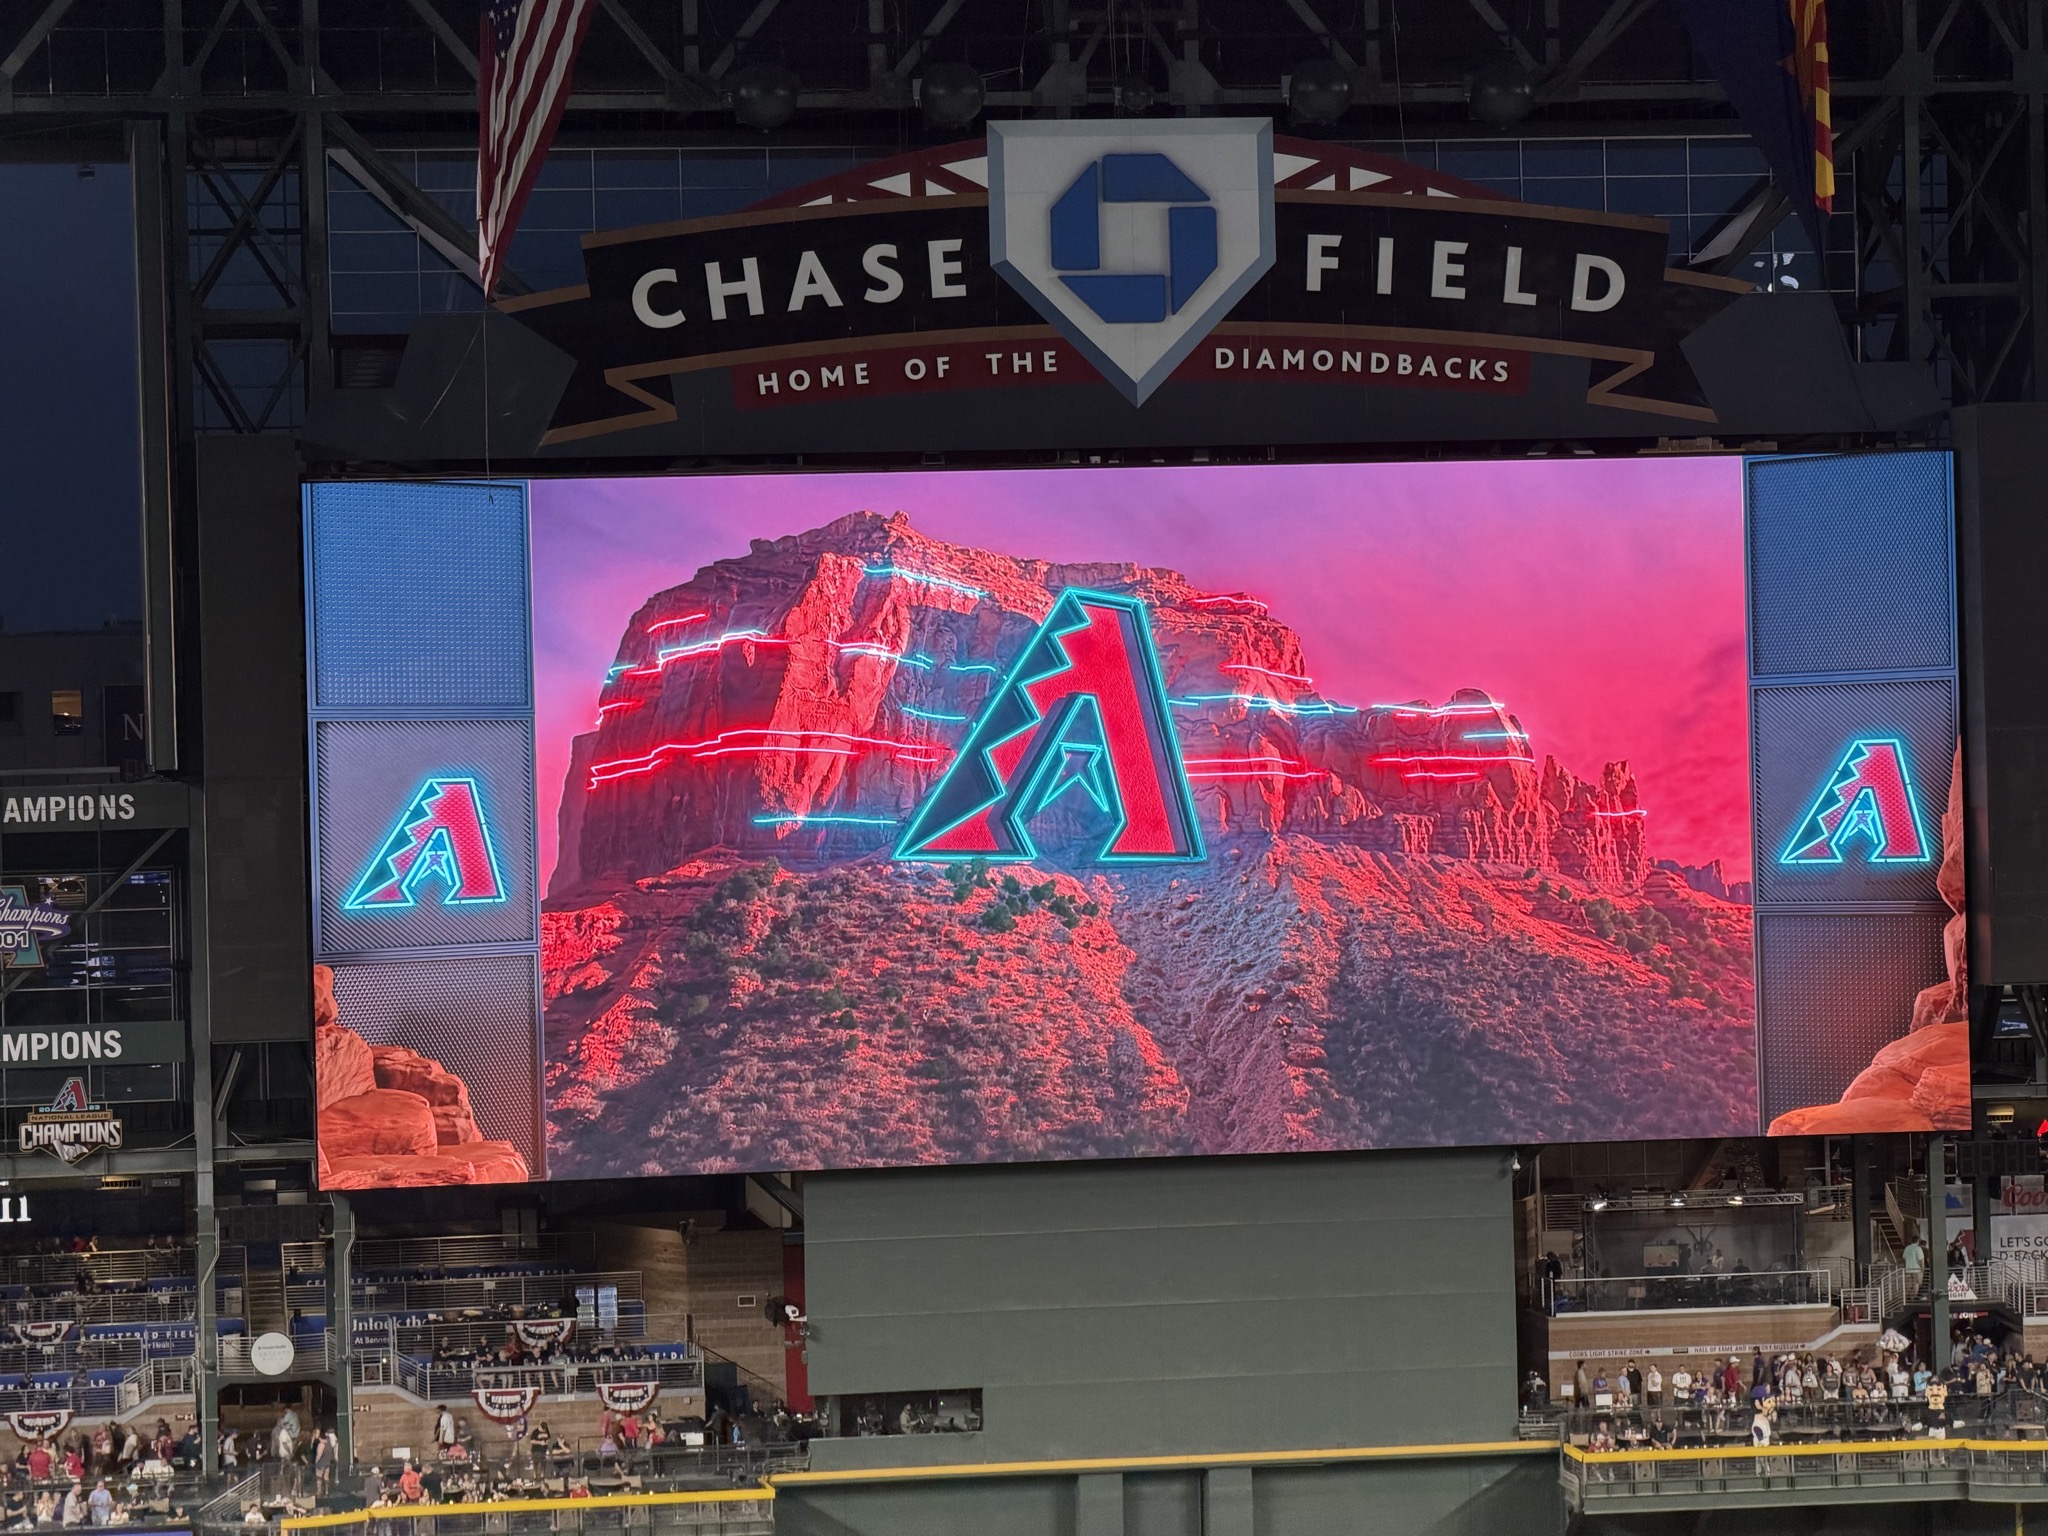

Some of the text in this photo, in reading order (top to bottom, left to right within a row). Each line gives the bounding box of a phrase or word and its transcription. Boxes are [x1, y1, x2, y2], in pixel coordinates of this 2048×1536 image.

[631, 233, 1626, 329] CHASE FIELD
[757, 347, 1509, 396] HOME OF THE DIAMONDBACKS
[3, 793, 136, 823] AMPIONS
[76, 1112, 109, 1120] LEAGUE
[21, 1121, 120, 1150] CHAMPIONS
[2000, 1236, 2031, 1248] LET'S
